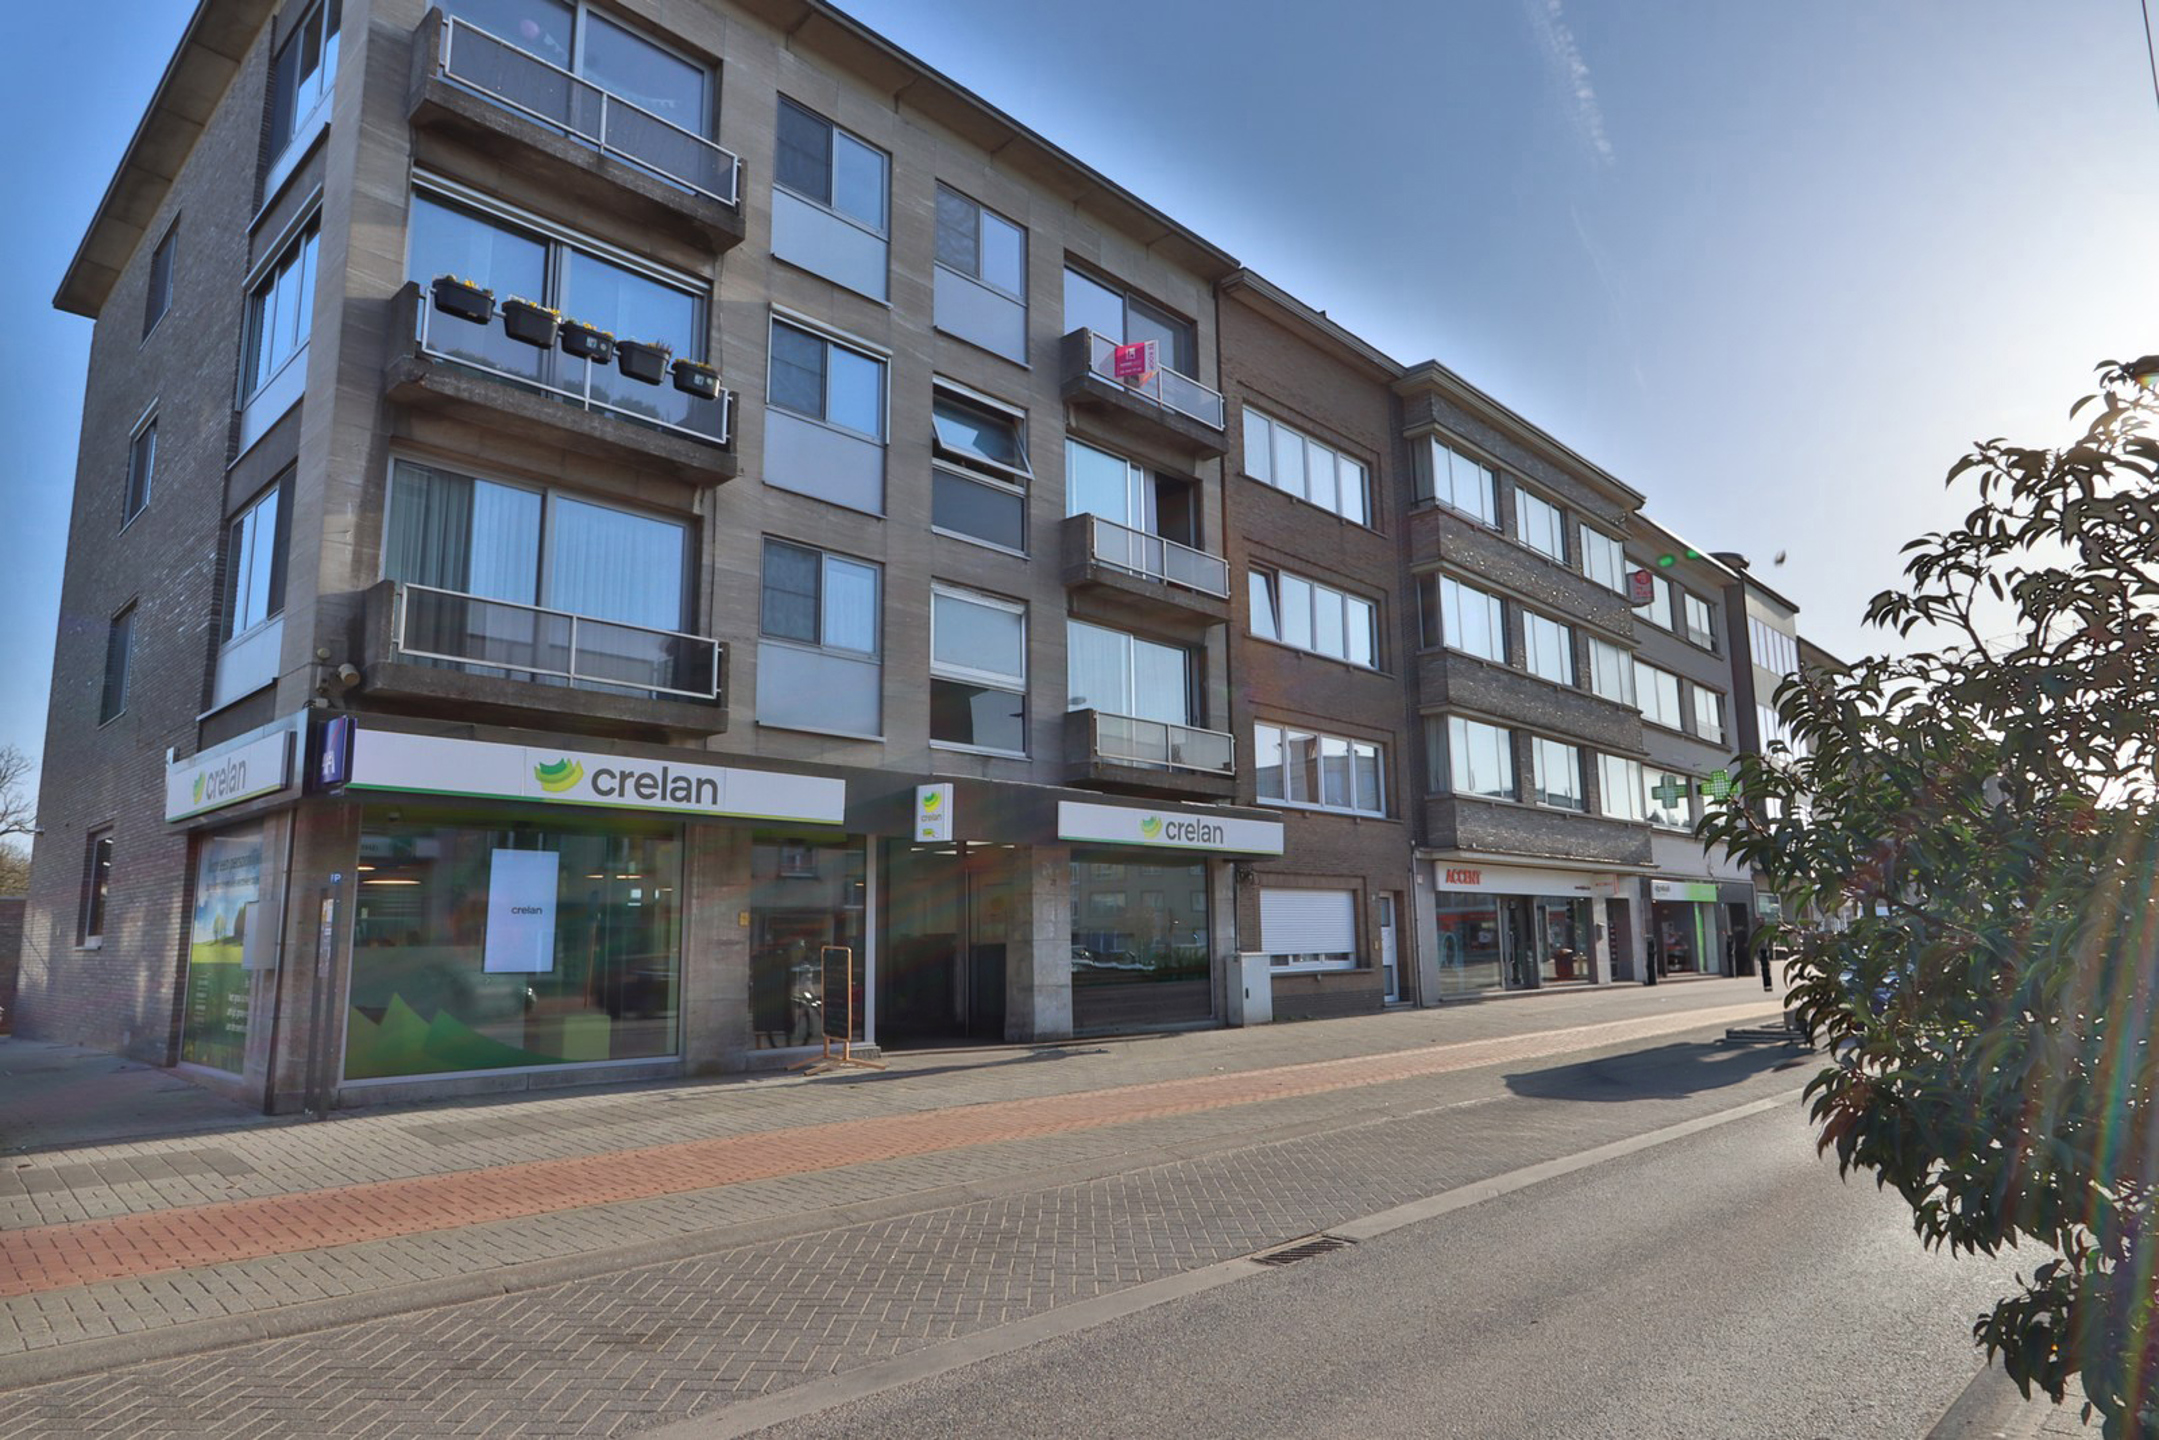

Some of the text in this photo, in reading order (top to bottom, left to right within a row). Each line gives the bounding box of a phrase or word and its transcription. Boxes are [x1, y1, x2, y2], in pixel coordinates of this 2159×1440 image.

[205, 757, 247, 800] crelan
[591, 766, 718, 805] crelan
[1165, 818, 1224, 844] crelan
[511, 905, 543, 915] crelan
